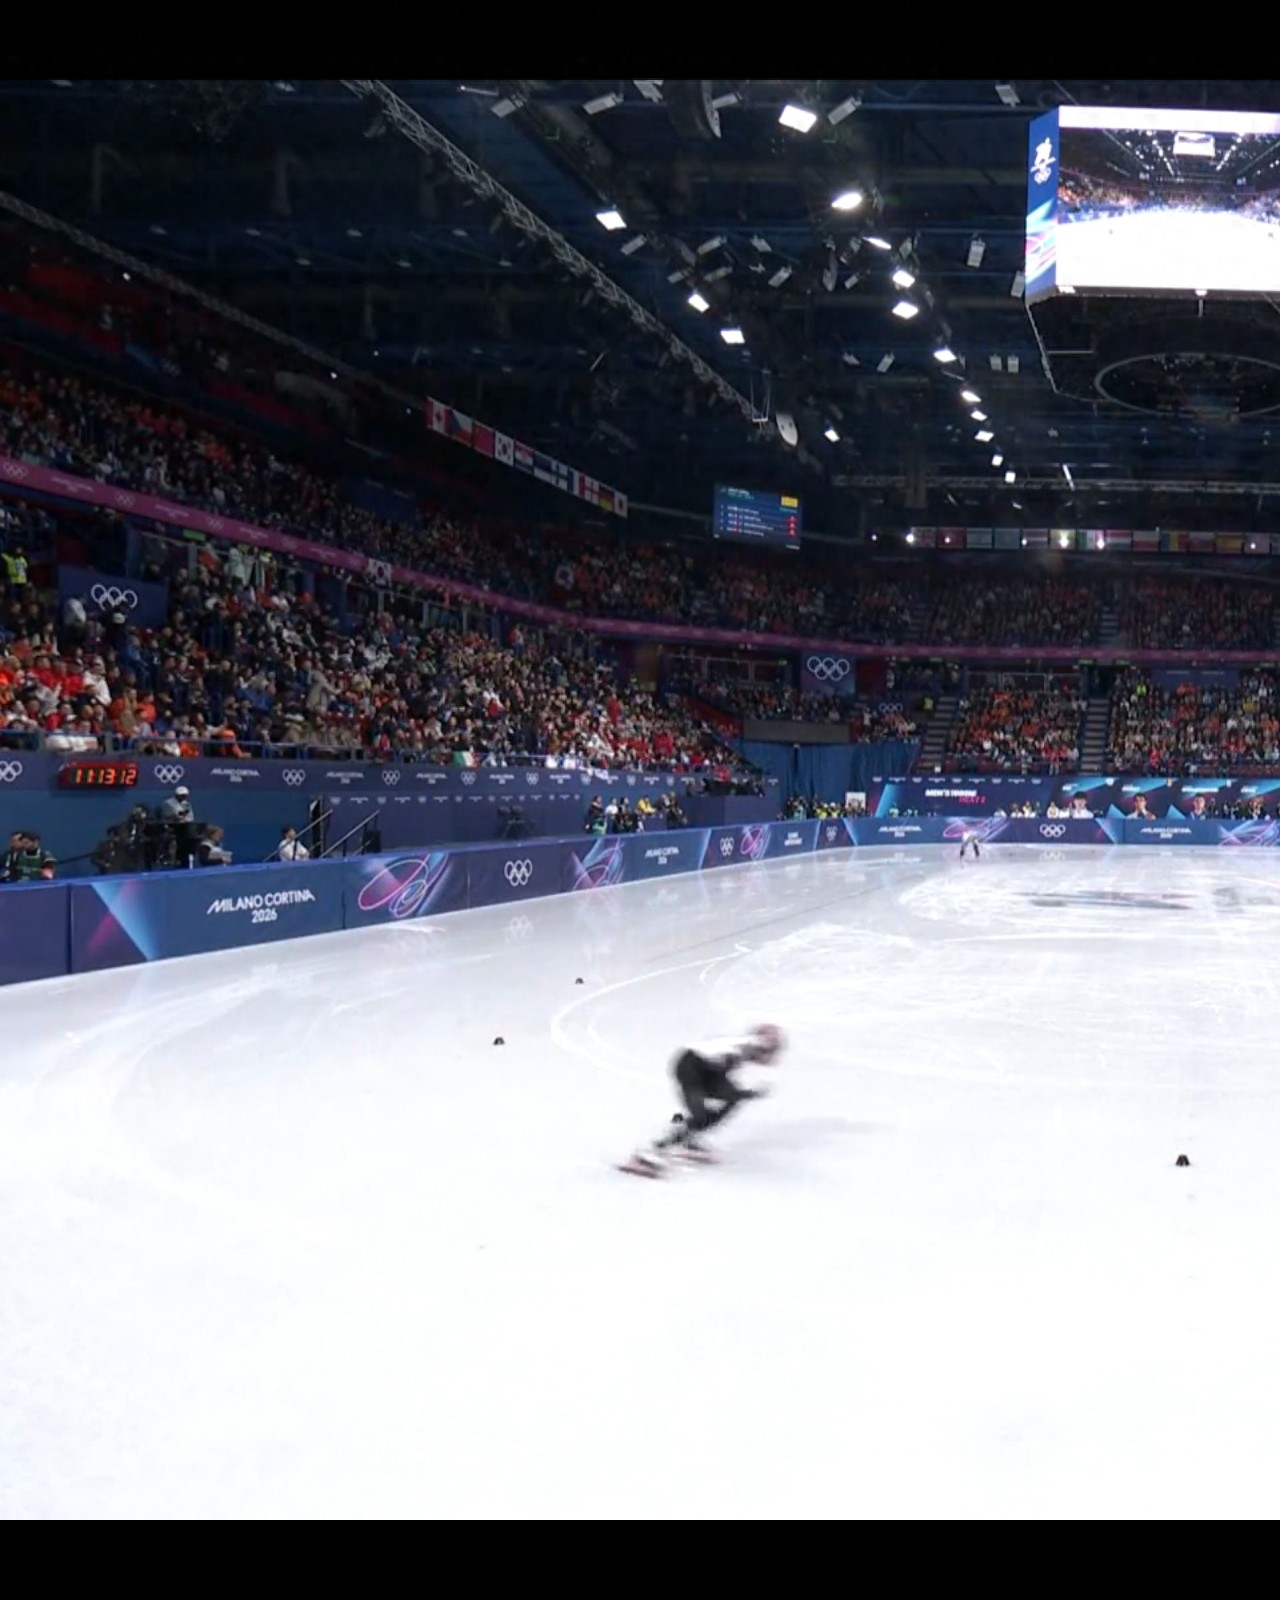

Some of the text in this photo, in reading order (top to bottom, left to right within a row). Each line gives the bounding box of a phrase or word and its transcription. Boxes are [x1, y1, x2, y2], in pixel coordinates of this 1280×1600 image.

[206, 889, 316, 914] MILANO CORTINA
[251, 908, 278, 923] 2026
